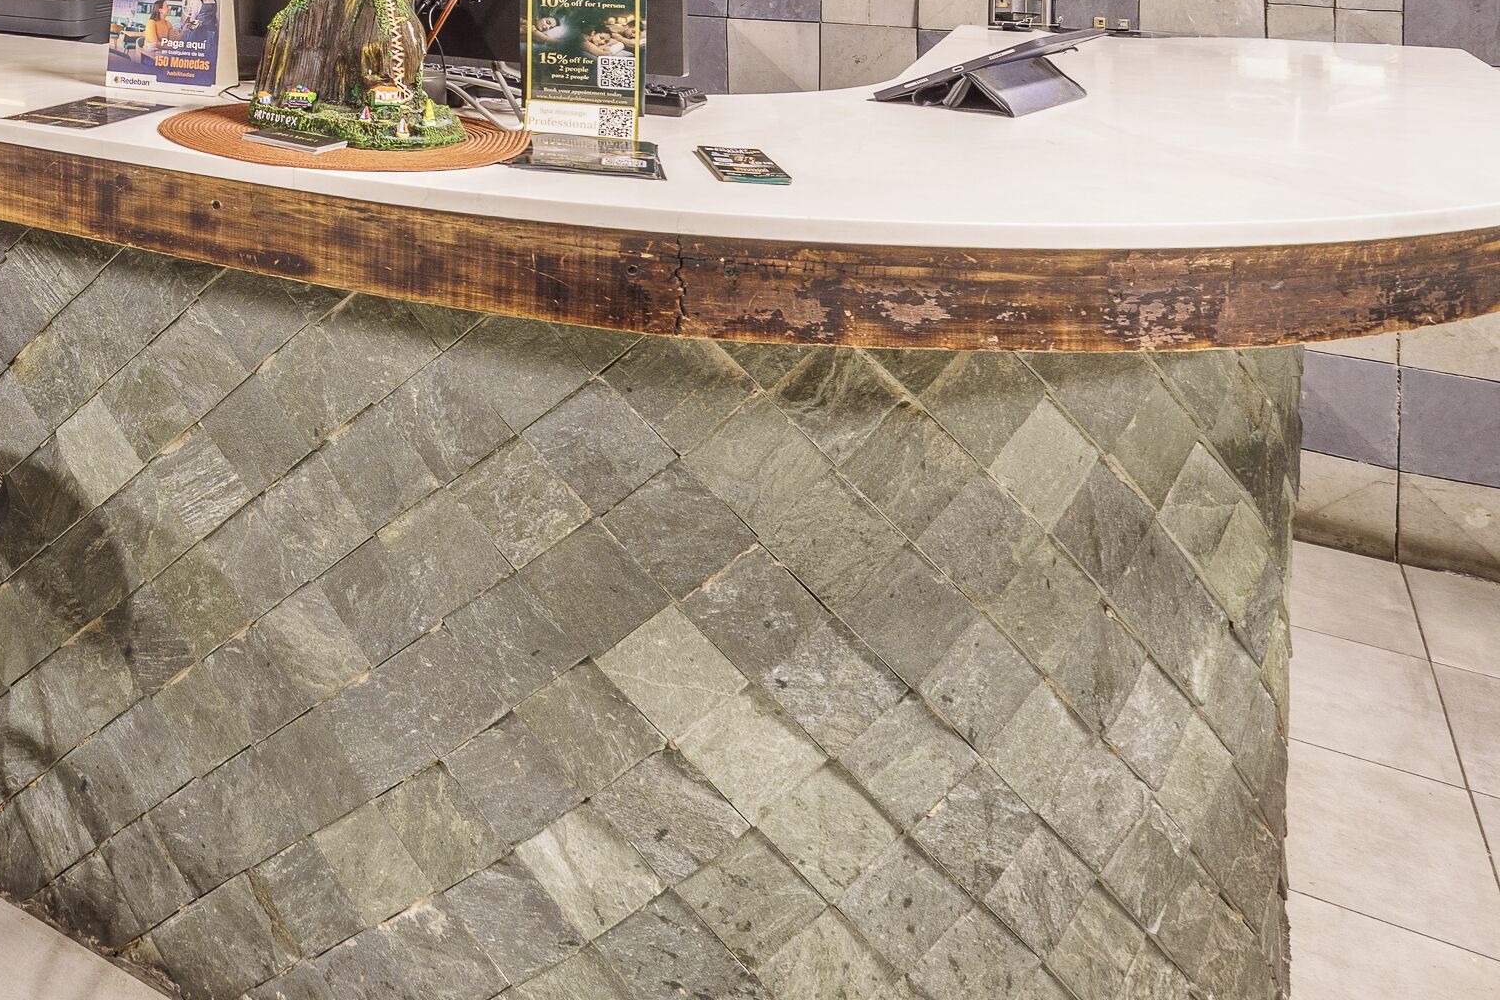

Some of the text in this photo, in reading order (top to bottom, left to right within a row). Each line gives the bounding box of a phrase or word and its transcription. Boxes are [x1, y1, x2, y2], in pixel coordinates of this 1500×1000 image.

[571, 0, 583, 7] off
[584, 0, 596, 8] for
[160, 38, 207, 50] Paga aquí
[155, 55, 210, 70] 150 Monedas
[538, 52, 594, 65] 15% off for
[166, 70, 196, 78] habilitadas
[120, 76, 150, 86] Redeban
[528, 116, 597, 129] Professional
